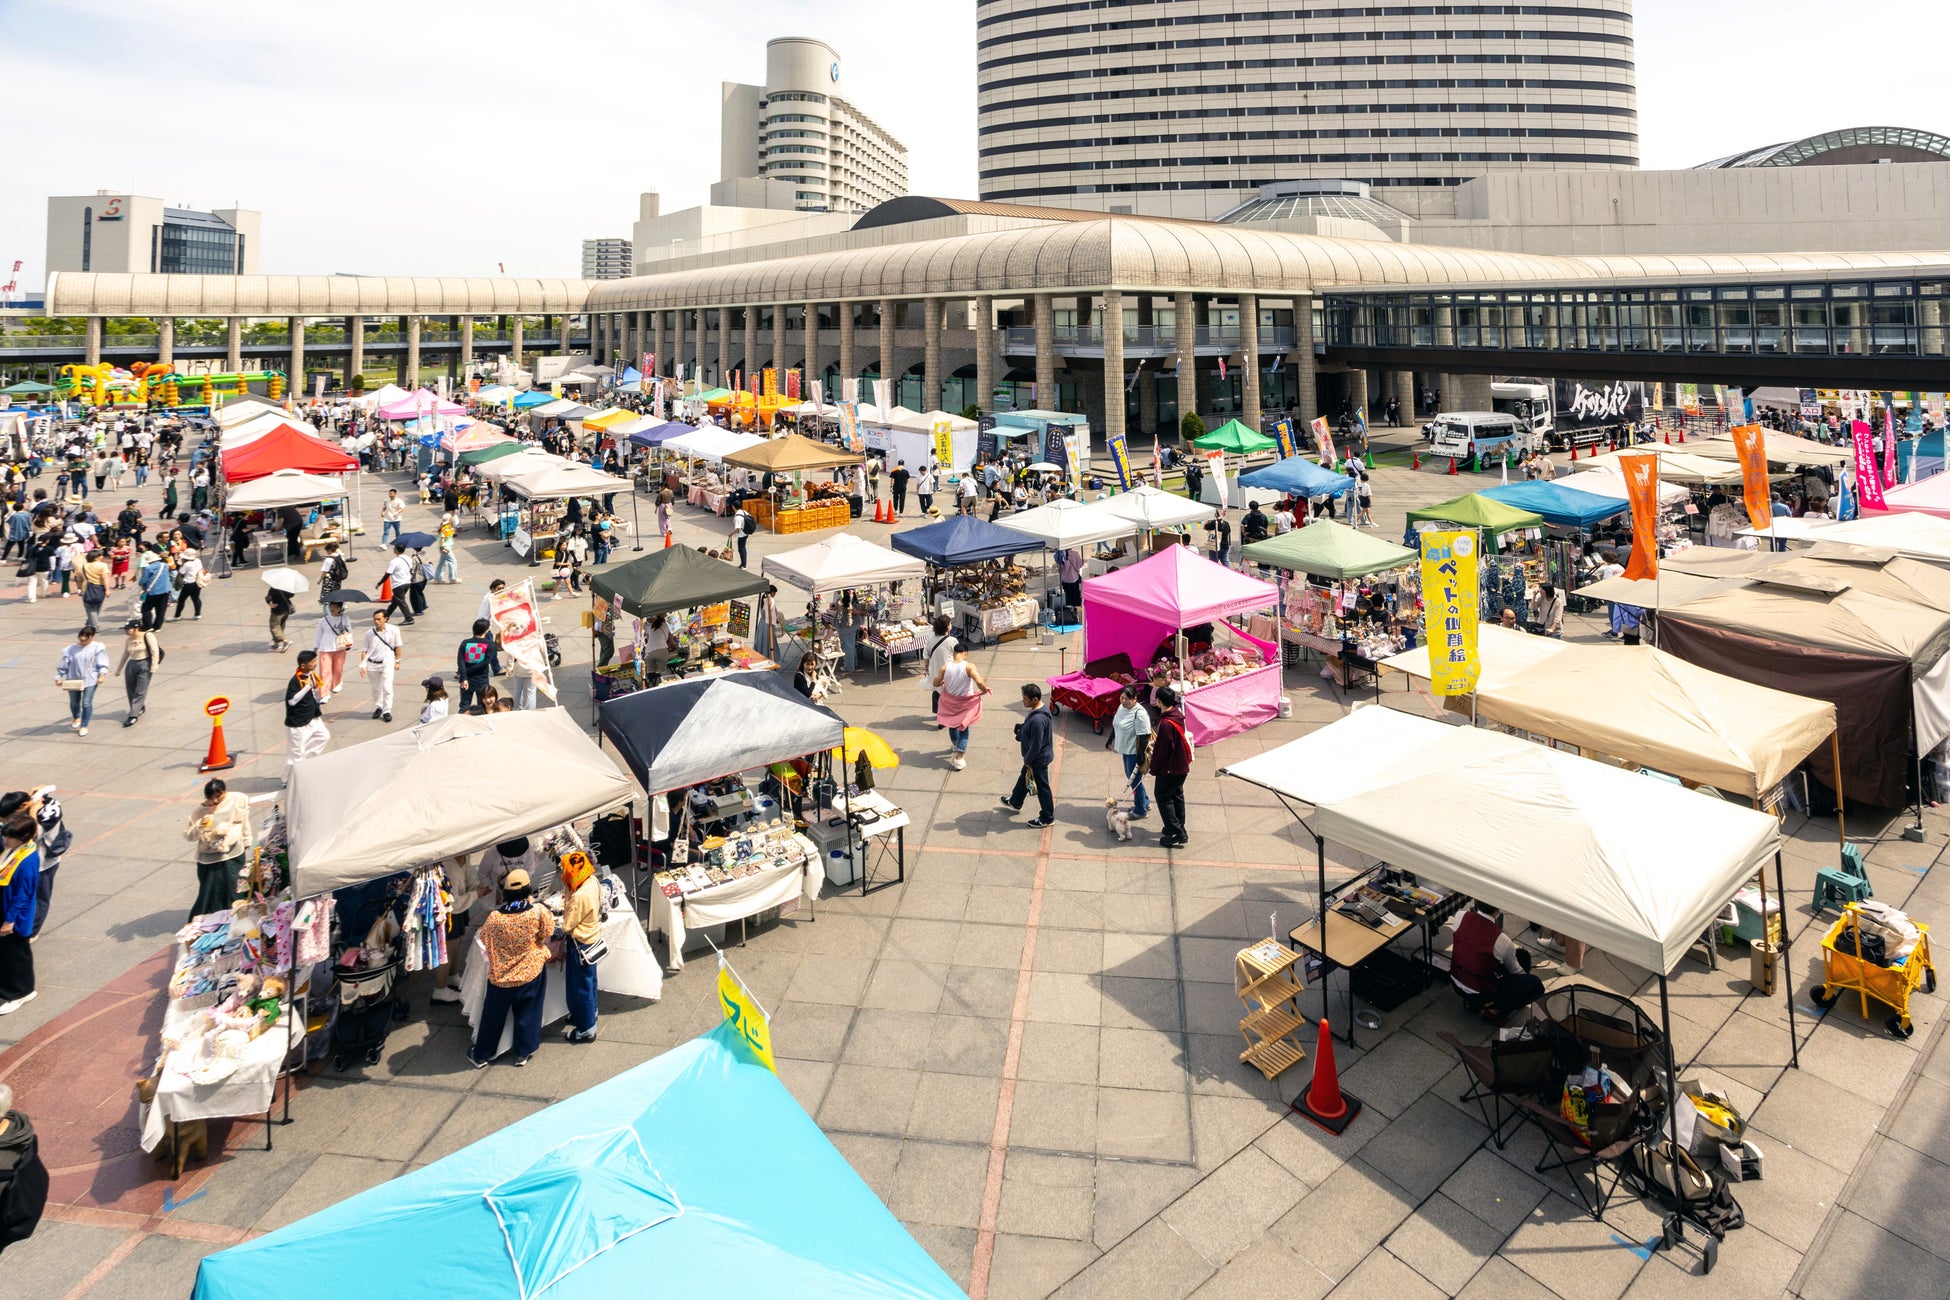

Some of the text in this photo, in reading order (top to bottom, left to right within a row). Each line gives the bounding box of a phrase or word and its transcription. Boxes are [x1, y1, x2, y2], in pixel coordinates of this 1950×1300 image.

[1438, 560, 1466, 663] ペットの似顔絵
